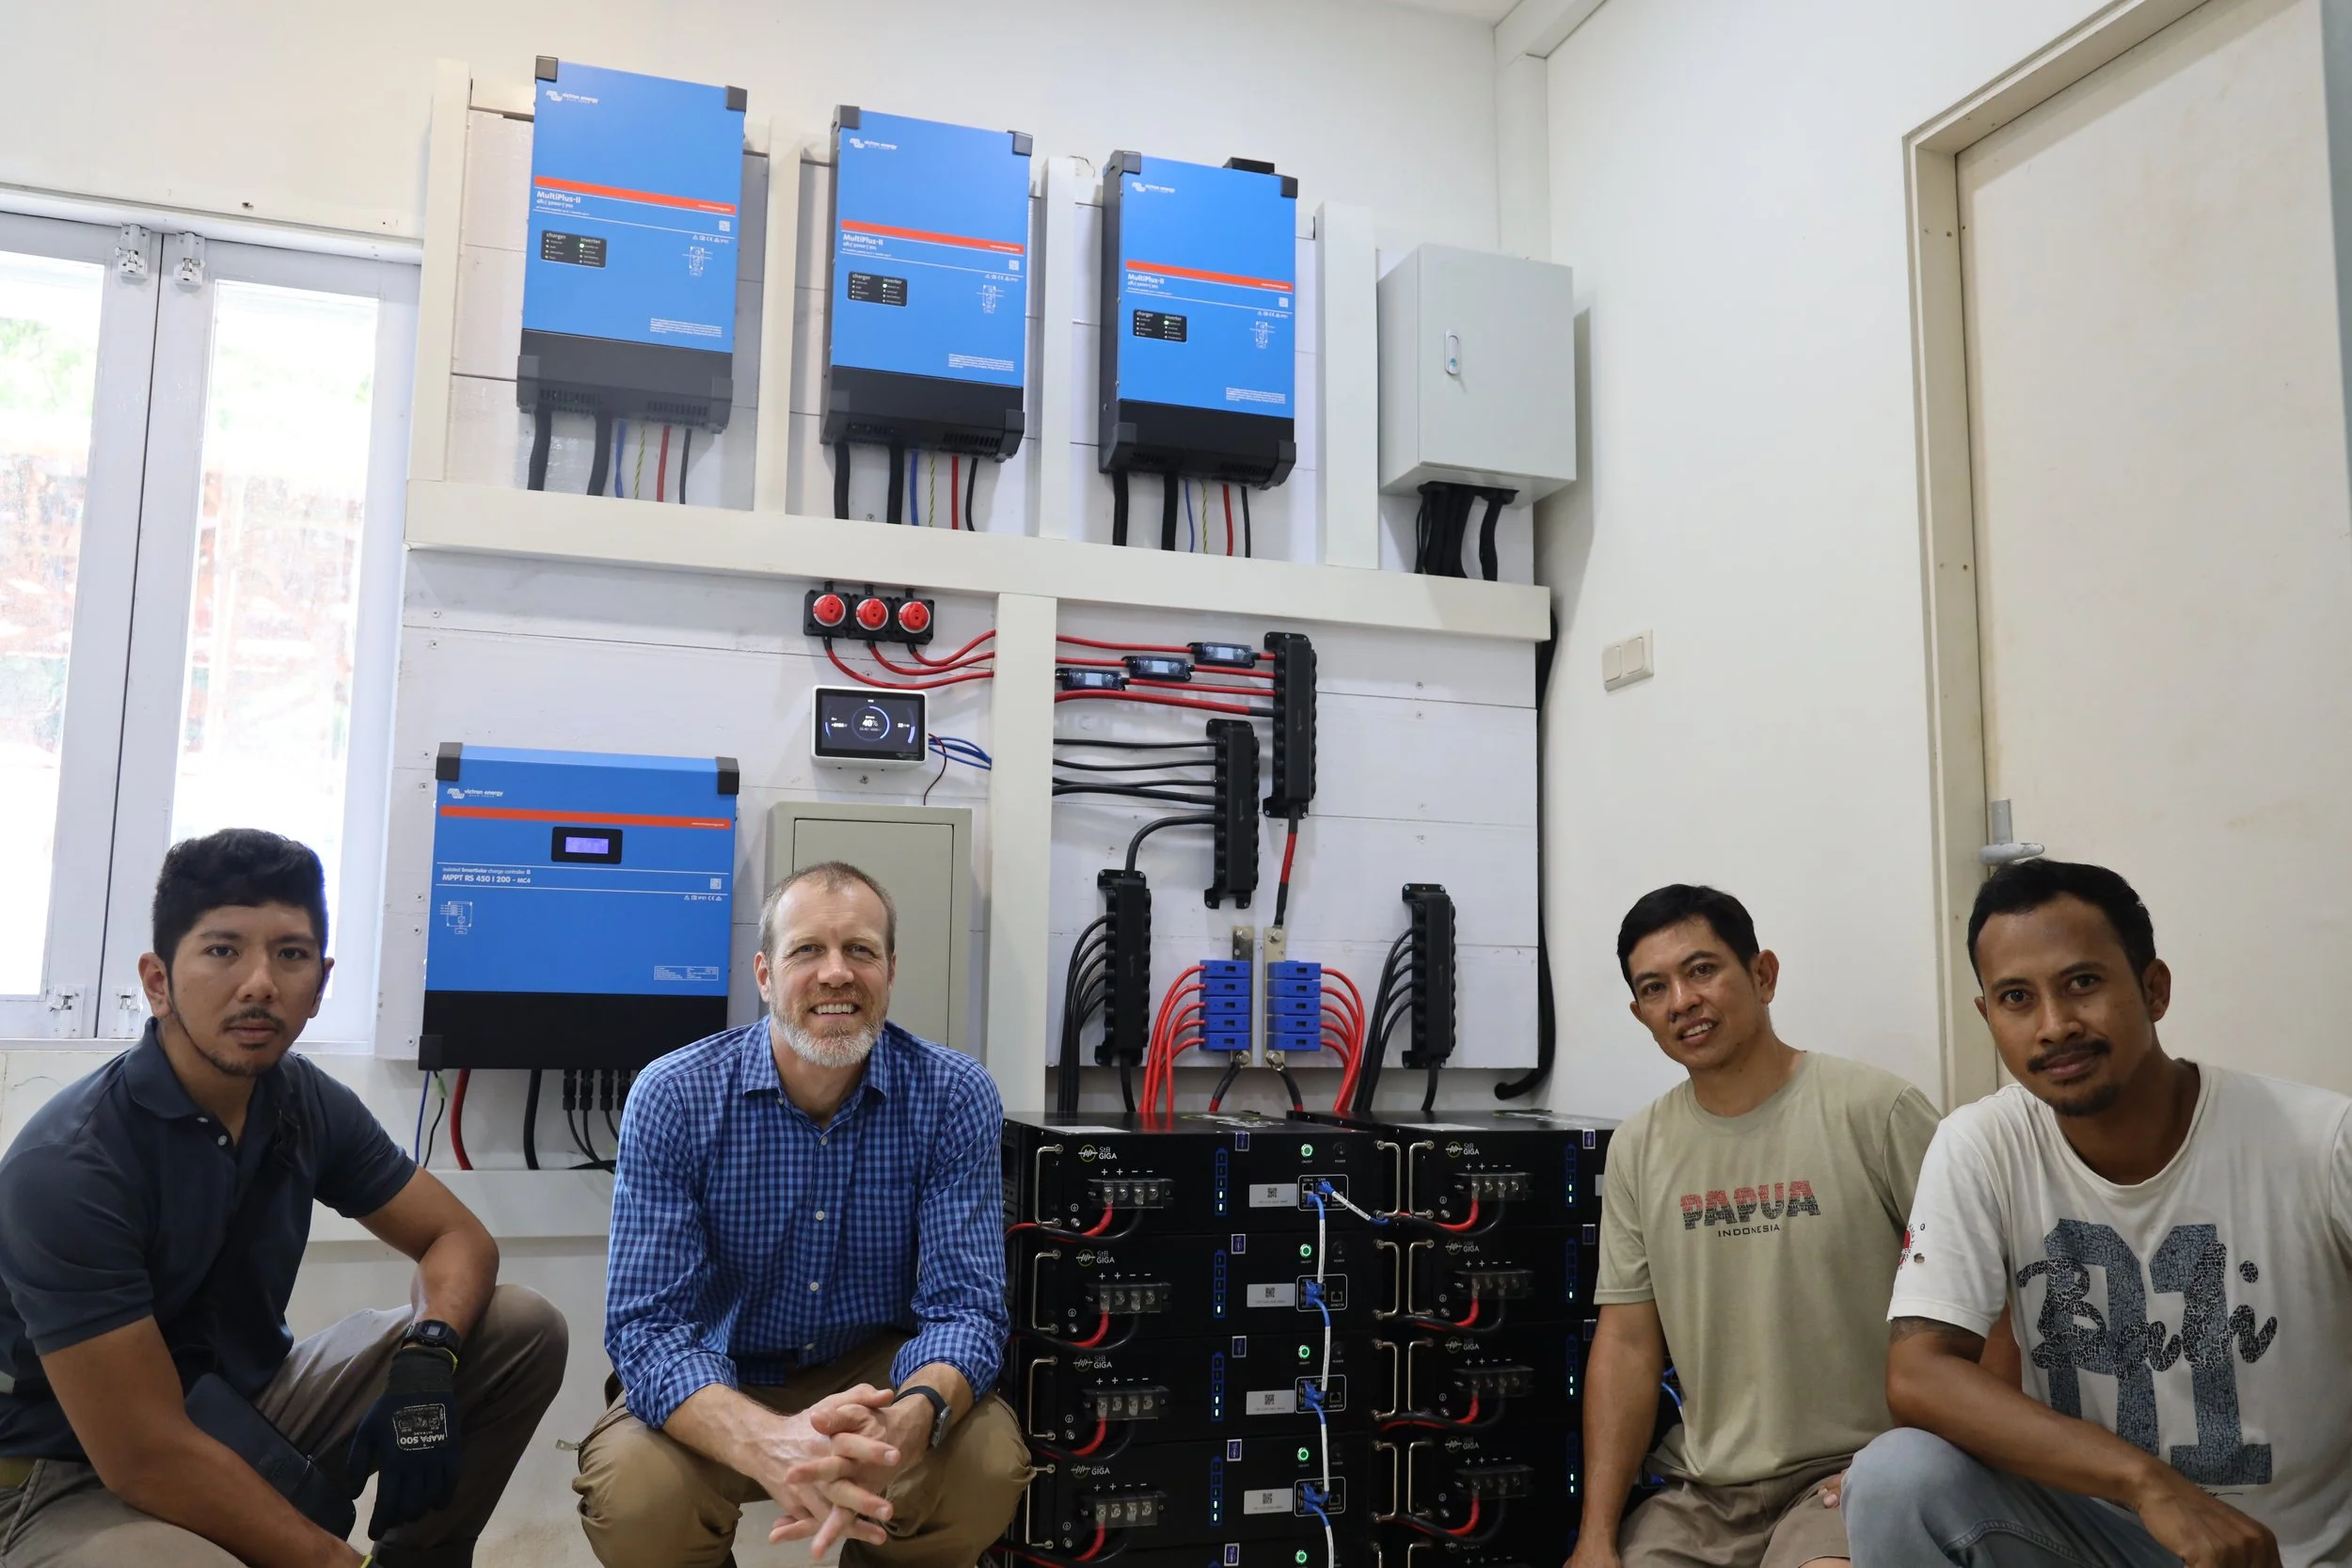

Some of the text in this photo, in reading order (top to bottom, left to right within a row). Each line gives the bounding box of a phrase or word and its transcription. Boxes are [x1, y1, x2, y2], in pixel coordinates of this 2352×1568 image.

[1679, 1180, 1822, 1230] PAPUA
[1718, 1224, 1781, 1238] INDONESIA
[400, 1436, 420, 1445] 500
[1462, 1442, 1480, 1450] GIGA
[1091, 1466, 1111, 1476] GIGA
